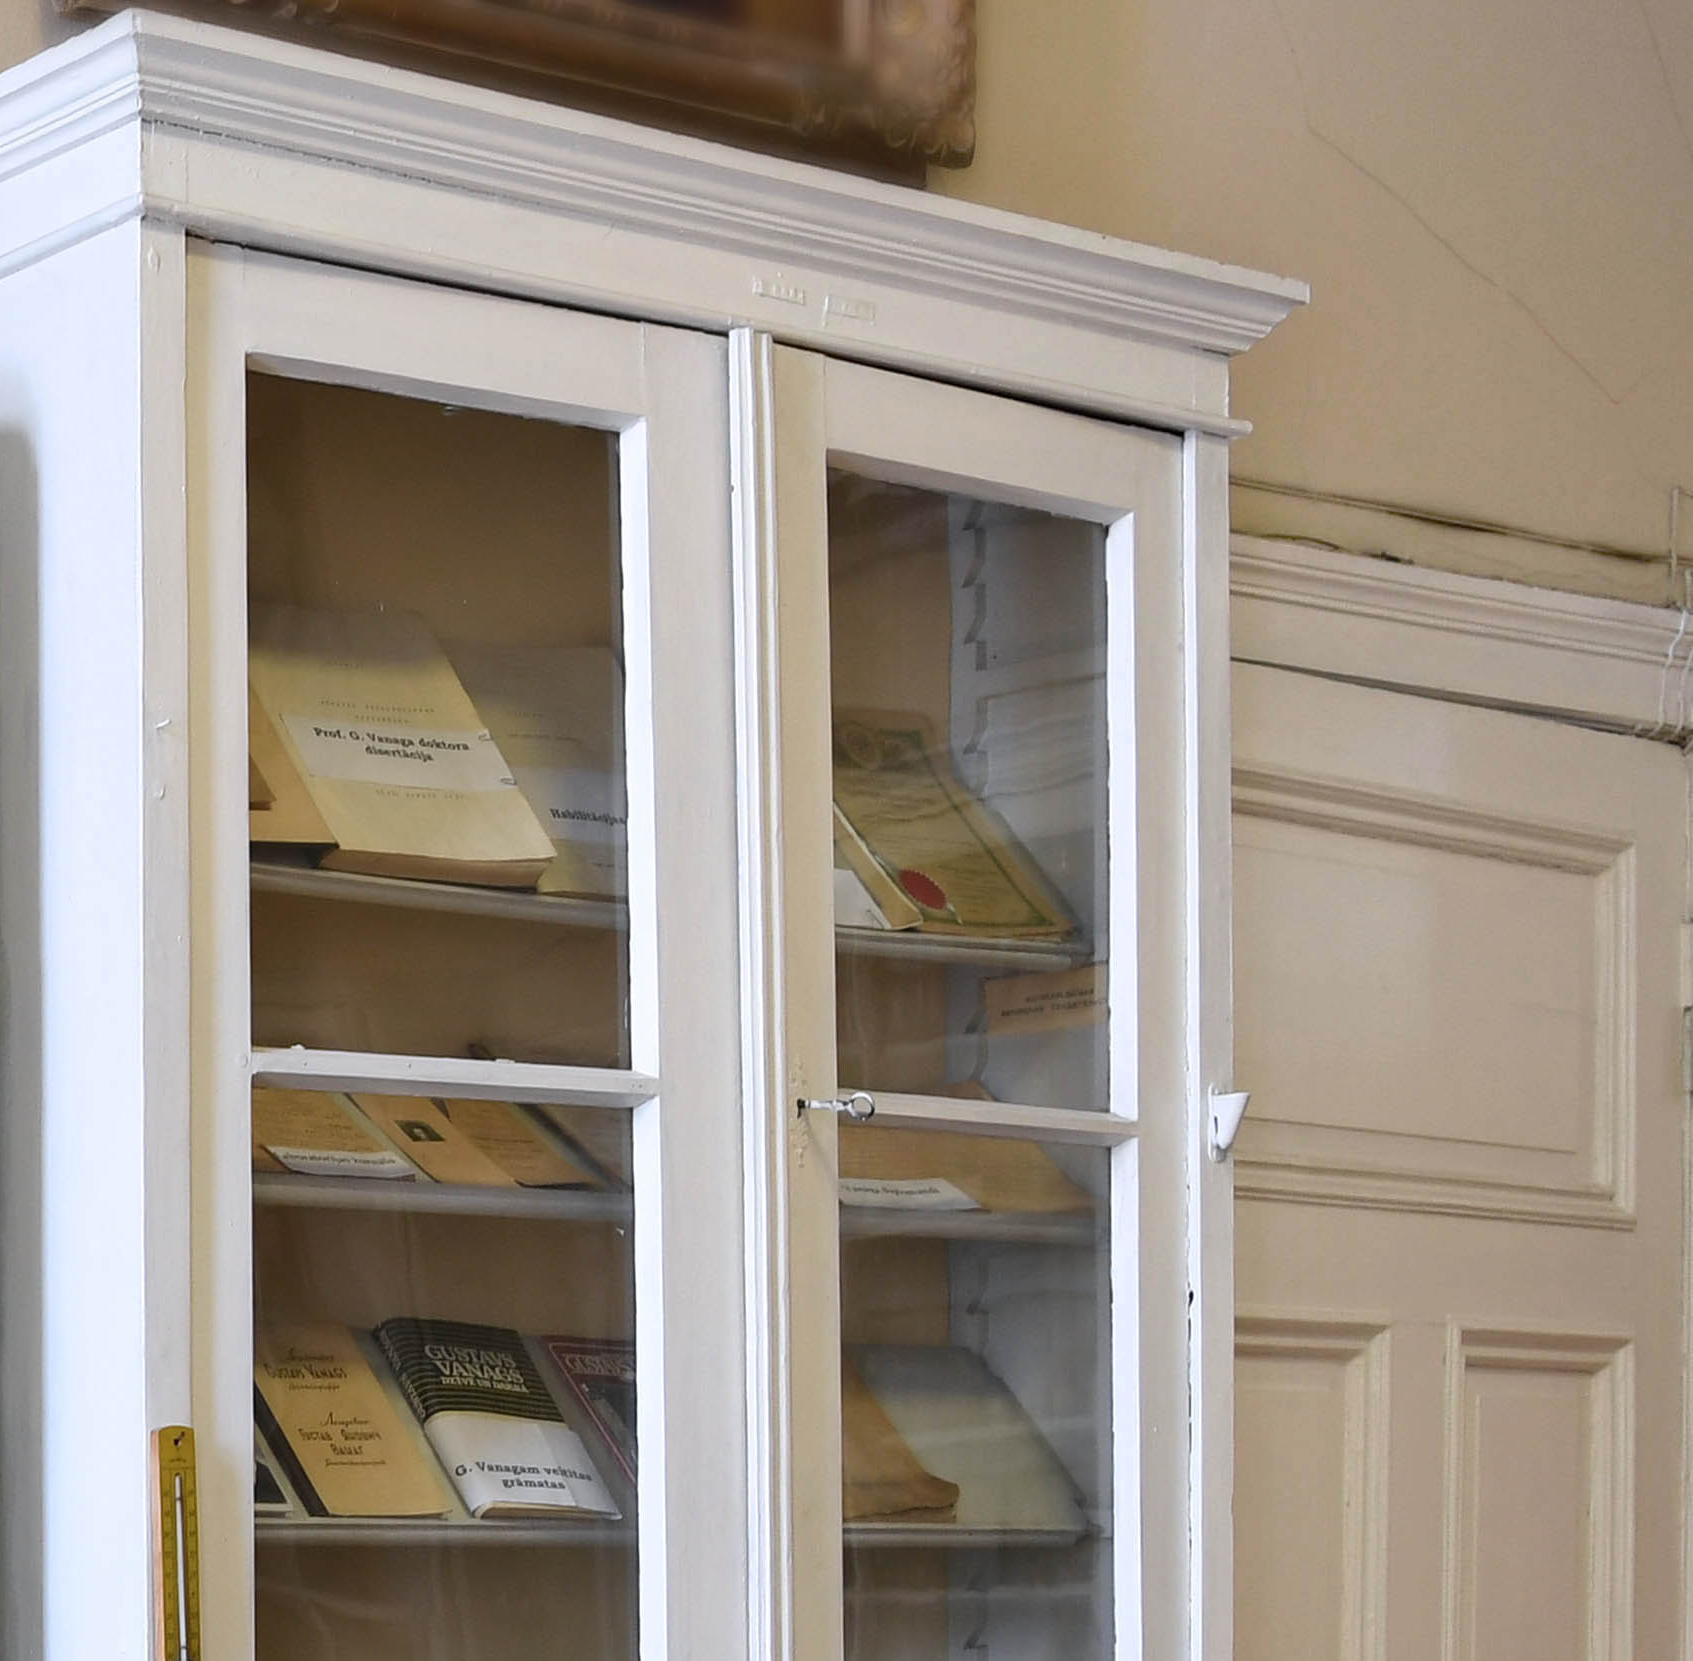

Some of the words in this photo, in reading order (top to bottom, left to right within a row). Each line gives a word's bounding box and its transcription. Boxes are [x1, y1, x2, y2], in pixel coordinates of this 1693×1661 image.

[313, 727, 346, 740] Prof.
[348, 731, 364, 742] G.
[367, 733, 415, 749] Vanaga
[418, 736, 469, 751] doktora
[364, 745, 433, 763] disertācija
[424, 1344, 517, 1368] GUSTAVS
[433, 1360, 525, 1384] VANAGS
[455, 1463, 472, 1477] G.
[476, 1461, 541, 1476] Vanagam
[502, 1478, 566, 1491] grāmatas
